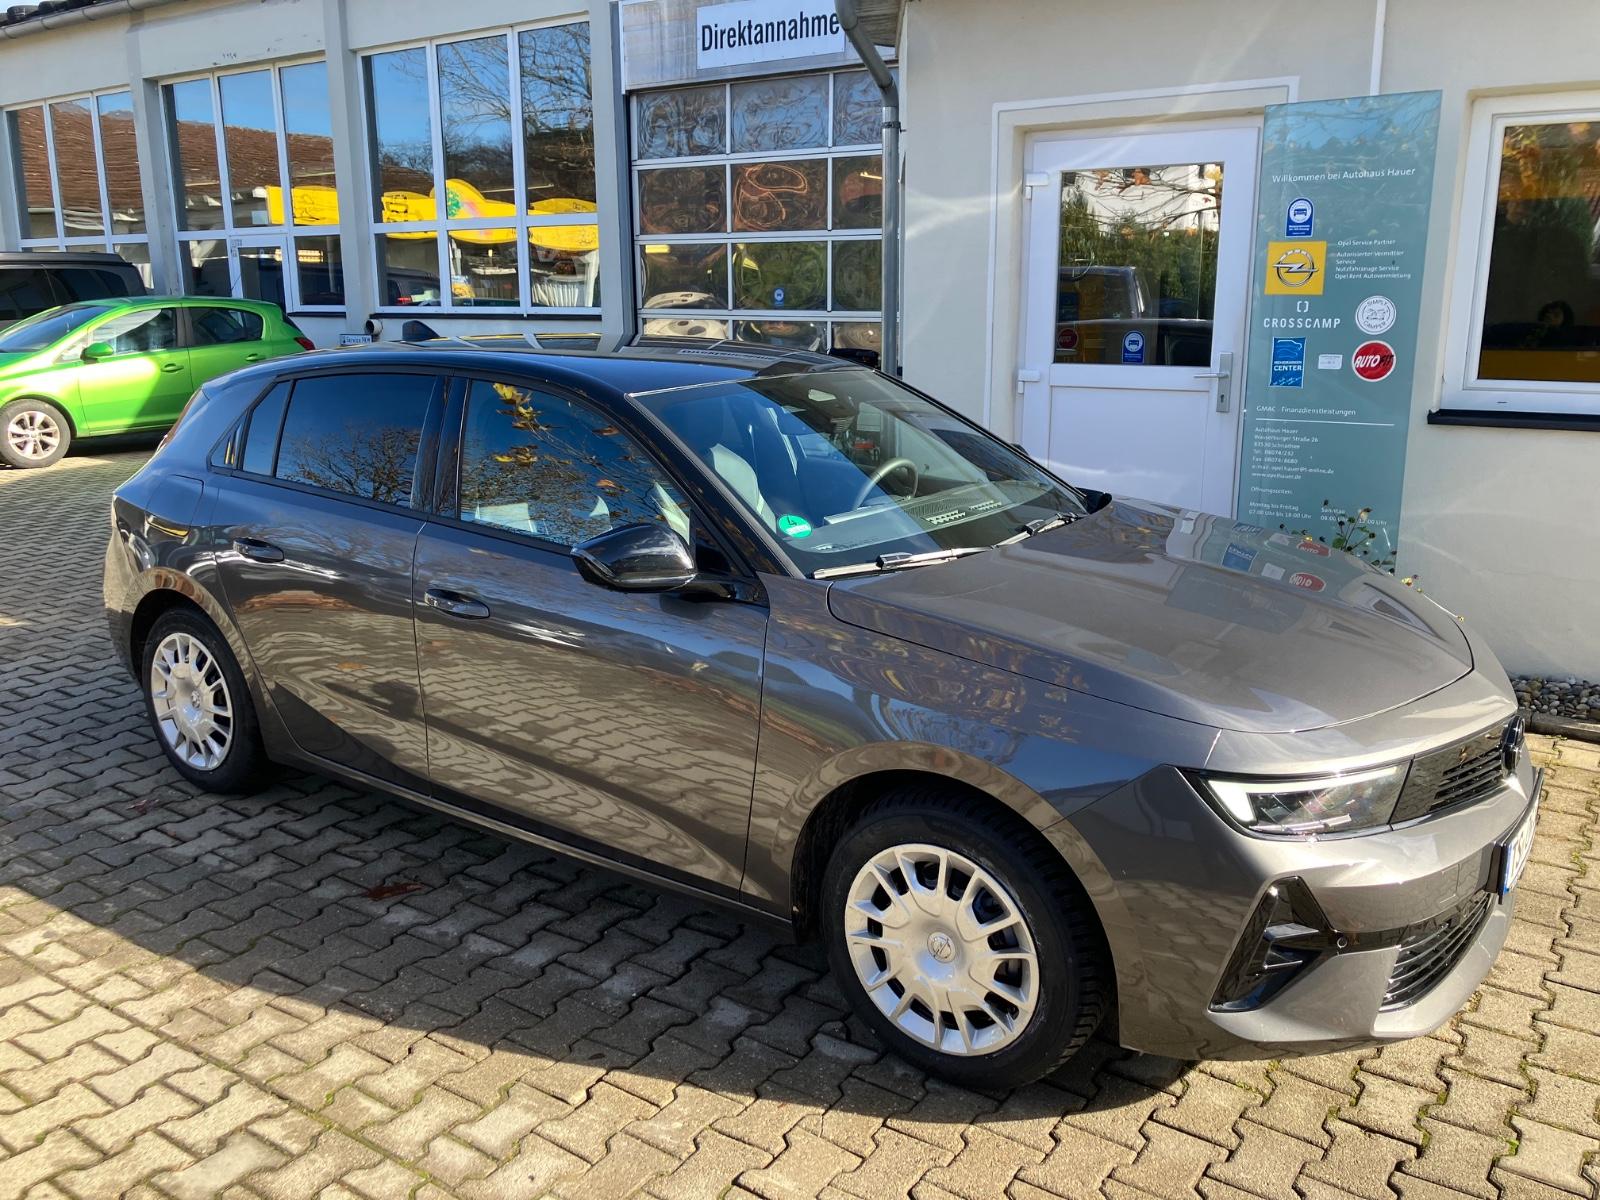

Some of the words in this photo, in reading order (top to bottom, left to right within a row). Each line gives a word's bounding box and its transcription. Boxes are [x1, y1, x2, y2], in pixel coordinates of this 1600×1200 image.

[701, 10, 840, 52] Direktannahme
[1272, 172, 1326, 183] Willkommen
[1327, 171, 1341, 180] bei
[1343, 169, 1385, 179] Autohaus
[1387, 167, 1416, 177] Hauer
[1263, 317, 1341, 329] CROSSCAMP
[1273, 364, 1302, 372] CENTER
[1281, 406, 1357, 417] Finanzdienstleistungen
[1249, 501, 1271, 510] Montag
[1279, 503, 1299, 512] Freitag
